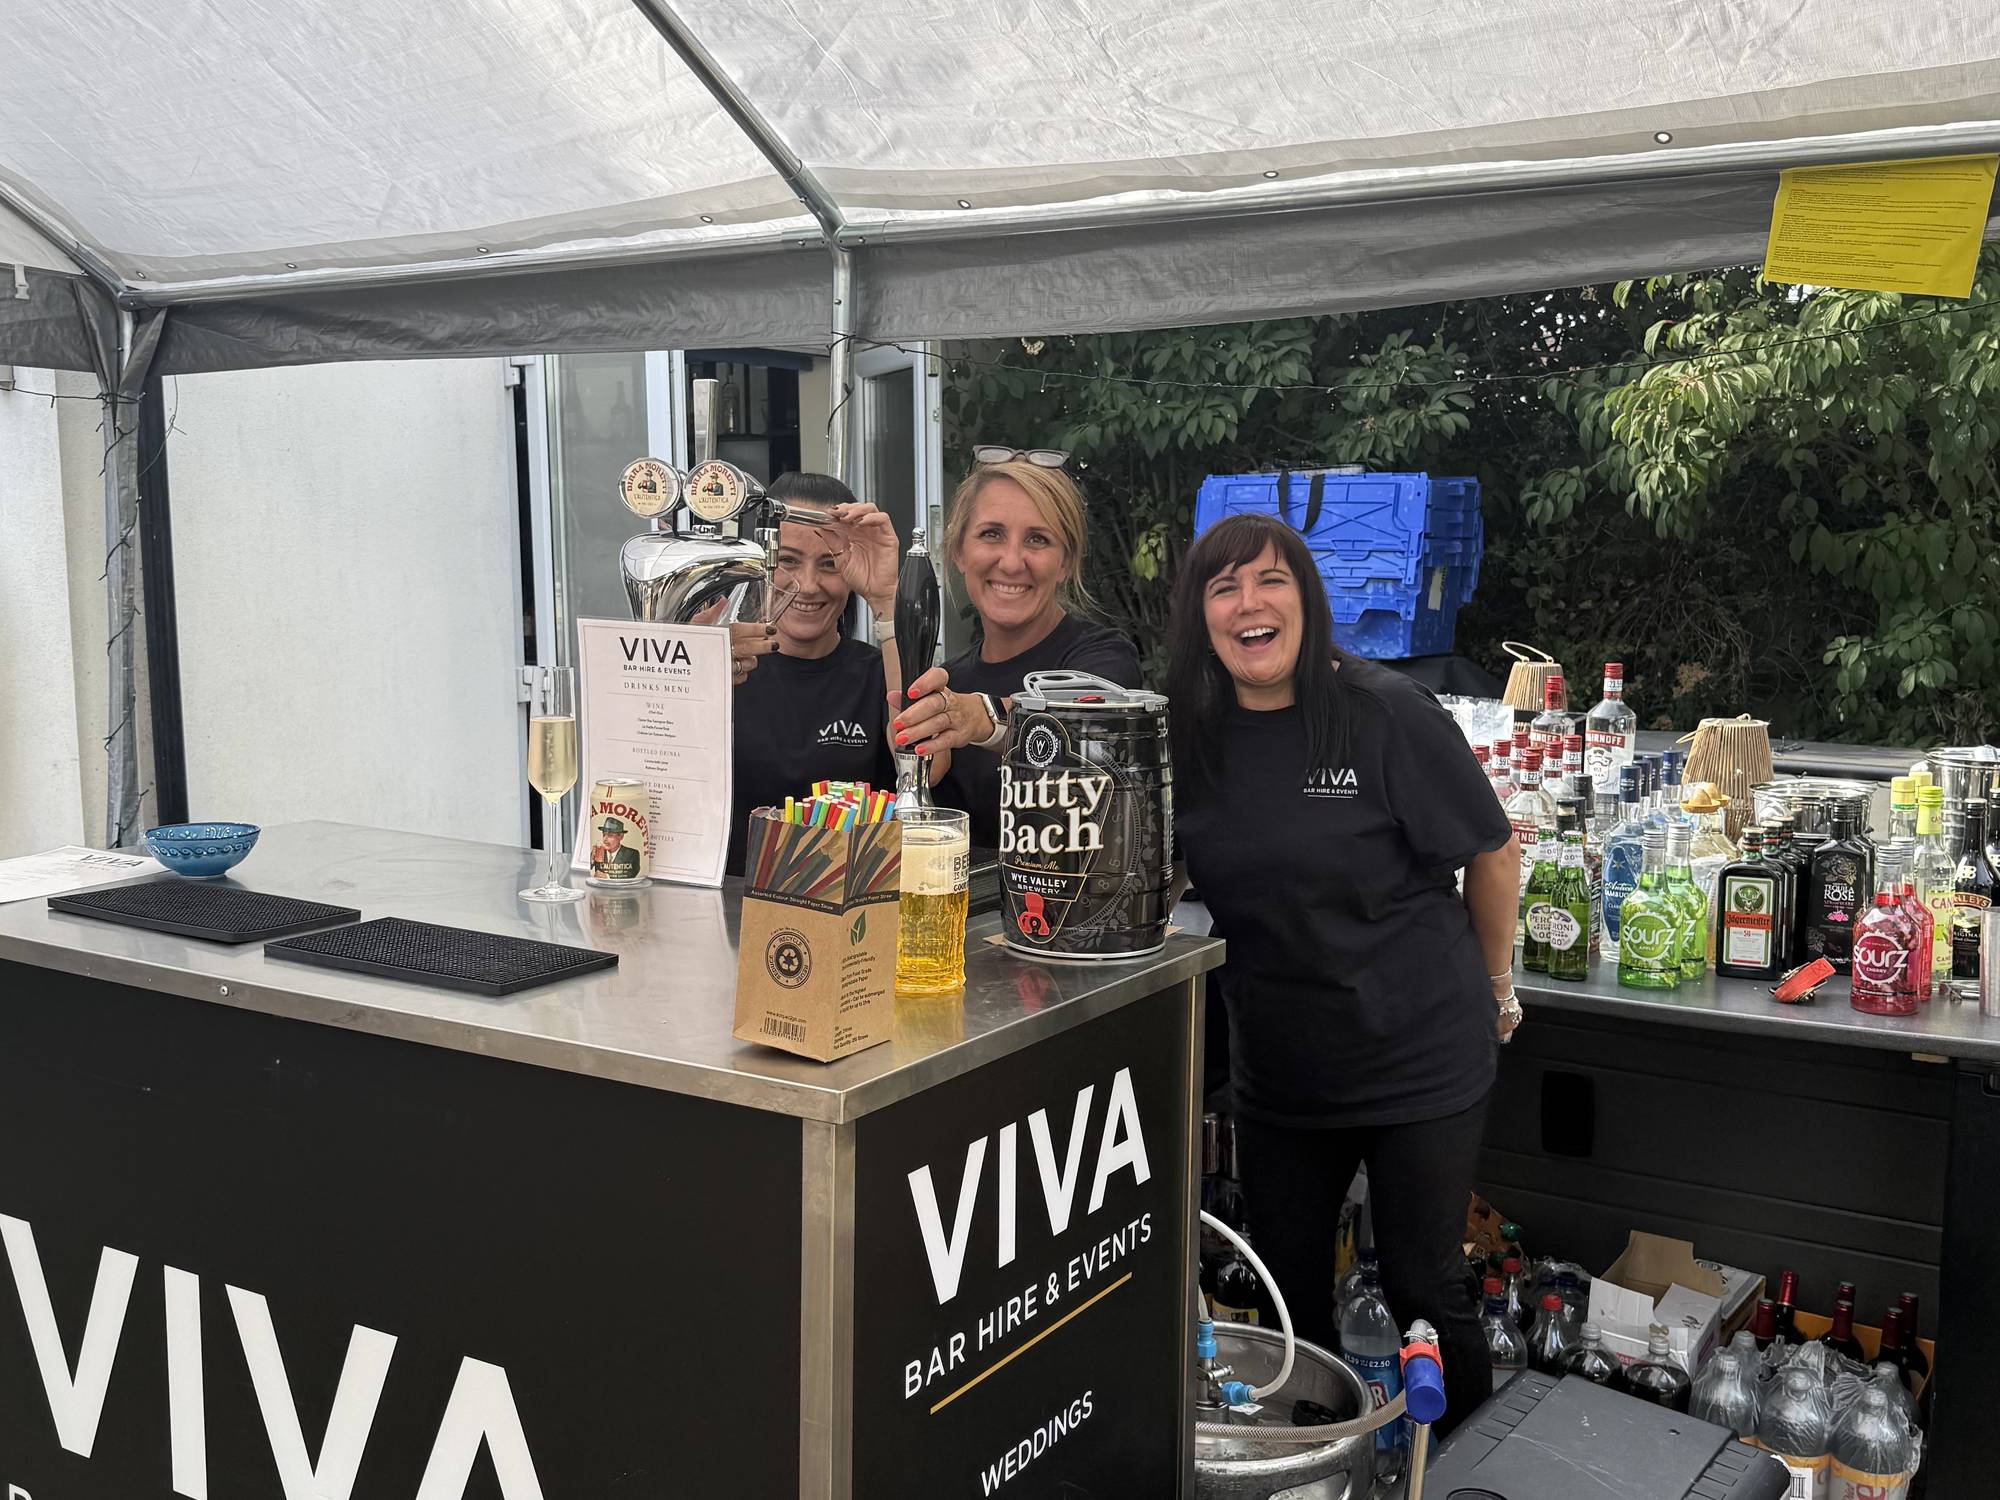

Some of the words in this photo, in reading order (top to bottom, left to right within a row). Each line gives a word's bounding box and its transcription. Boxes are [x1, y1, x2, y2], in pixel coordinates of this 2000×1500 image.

[619, 636, 692, 666] VIVA
[640, 665, 656, 673] HIRE
[664, 667, 691, 676] EVENTS
[624, 681, 660, 691] DRINKS
[664, 685, 690, 694] MENU
[819, 719, 866, 737] VIVA
[1306, 768, 1358, 786] VIVA
[998, 765, 1111, 816] Butty
[1000, 806, 1104, 854] Bach
[1015, 855, 1041, 869] Premium
[1043, 861, 1060, 870] Ale
[1011, 872, 1028, 884] WYE
[1030, 877, 1067, 888] VALLEY
[1017, 884, 1060, 894] BREWERY
[1823, 889, 1855, 901] ROSE
[1824, 885, 1854, 894] TEQUILA
[778, 935, 803, 947] RECYCLE
[1866, 965, 1887, 975] CHERRY
[908, 1067, 1151, 1306] VIVA
[905, 1331, 966, 1399] BAR
[978, 1284, 1038, 1351] HIRE
[1046, 1271, 1060, 1306] &
[1067, 1212, 1152, 1293] EVENTS
[0, 1213, 544, 1500] VIVA
[981, 1390, 1094, 1498] WEDDINGS
